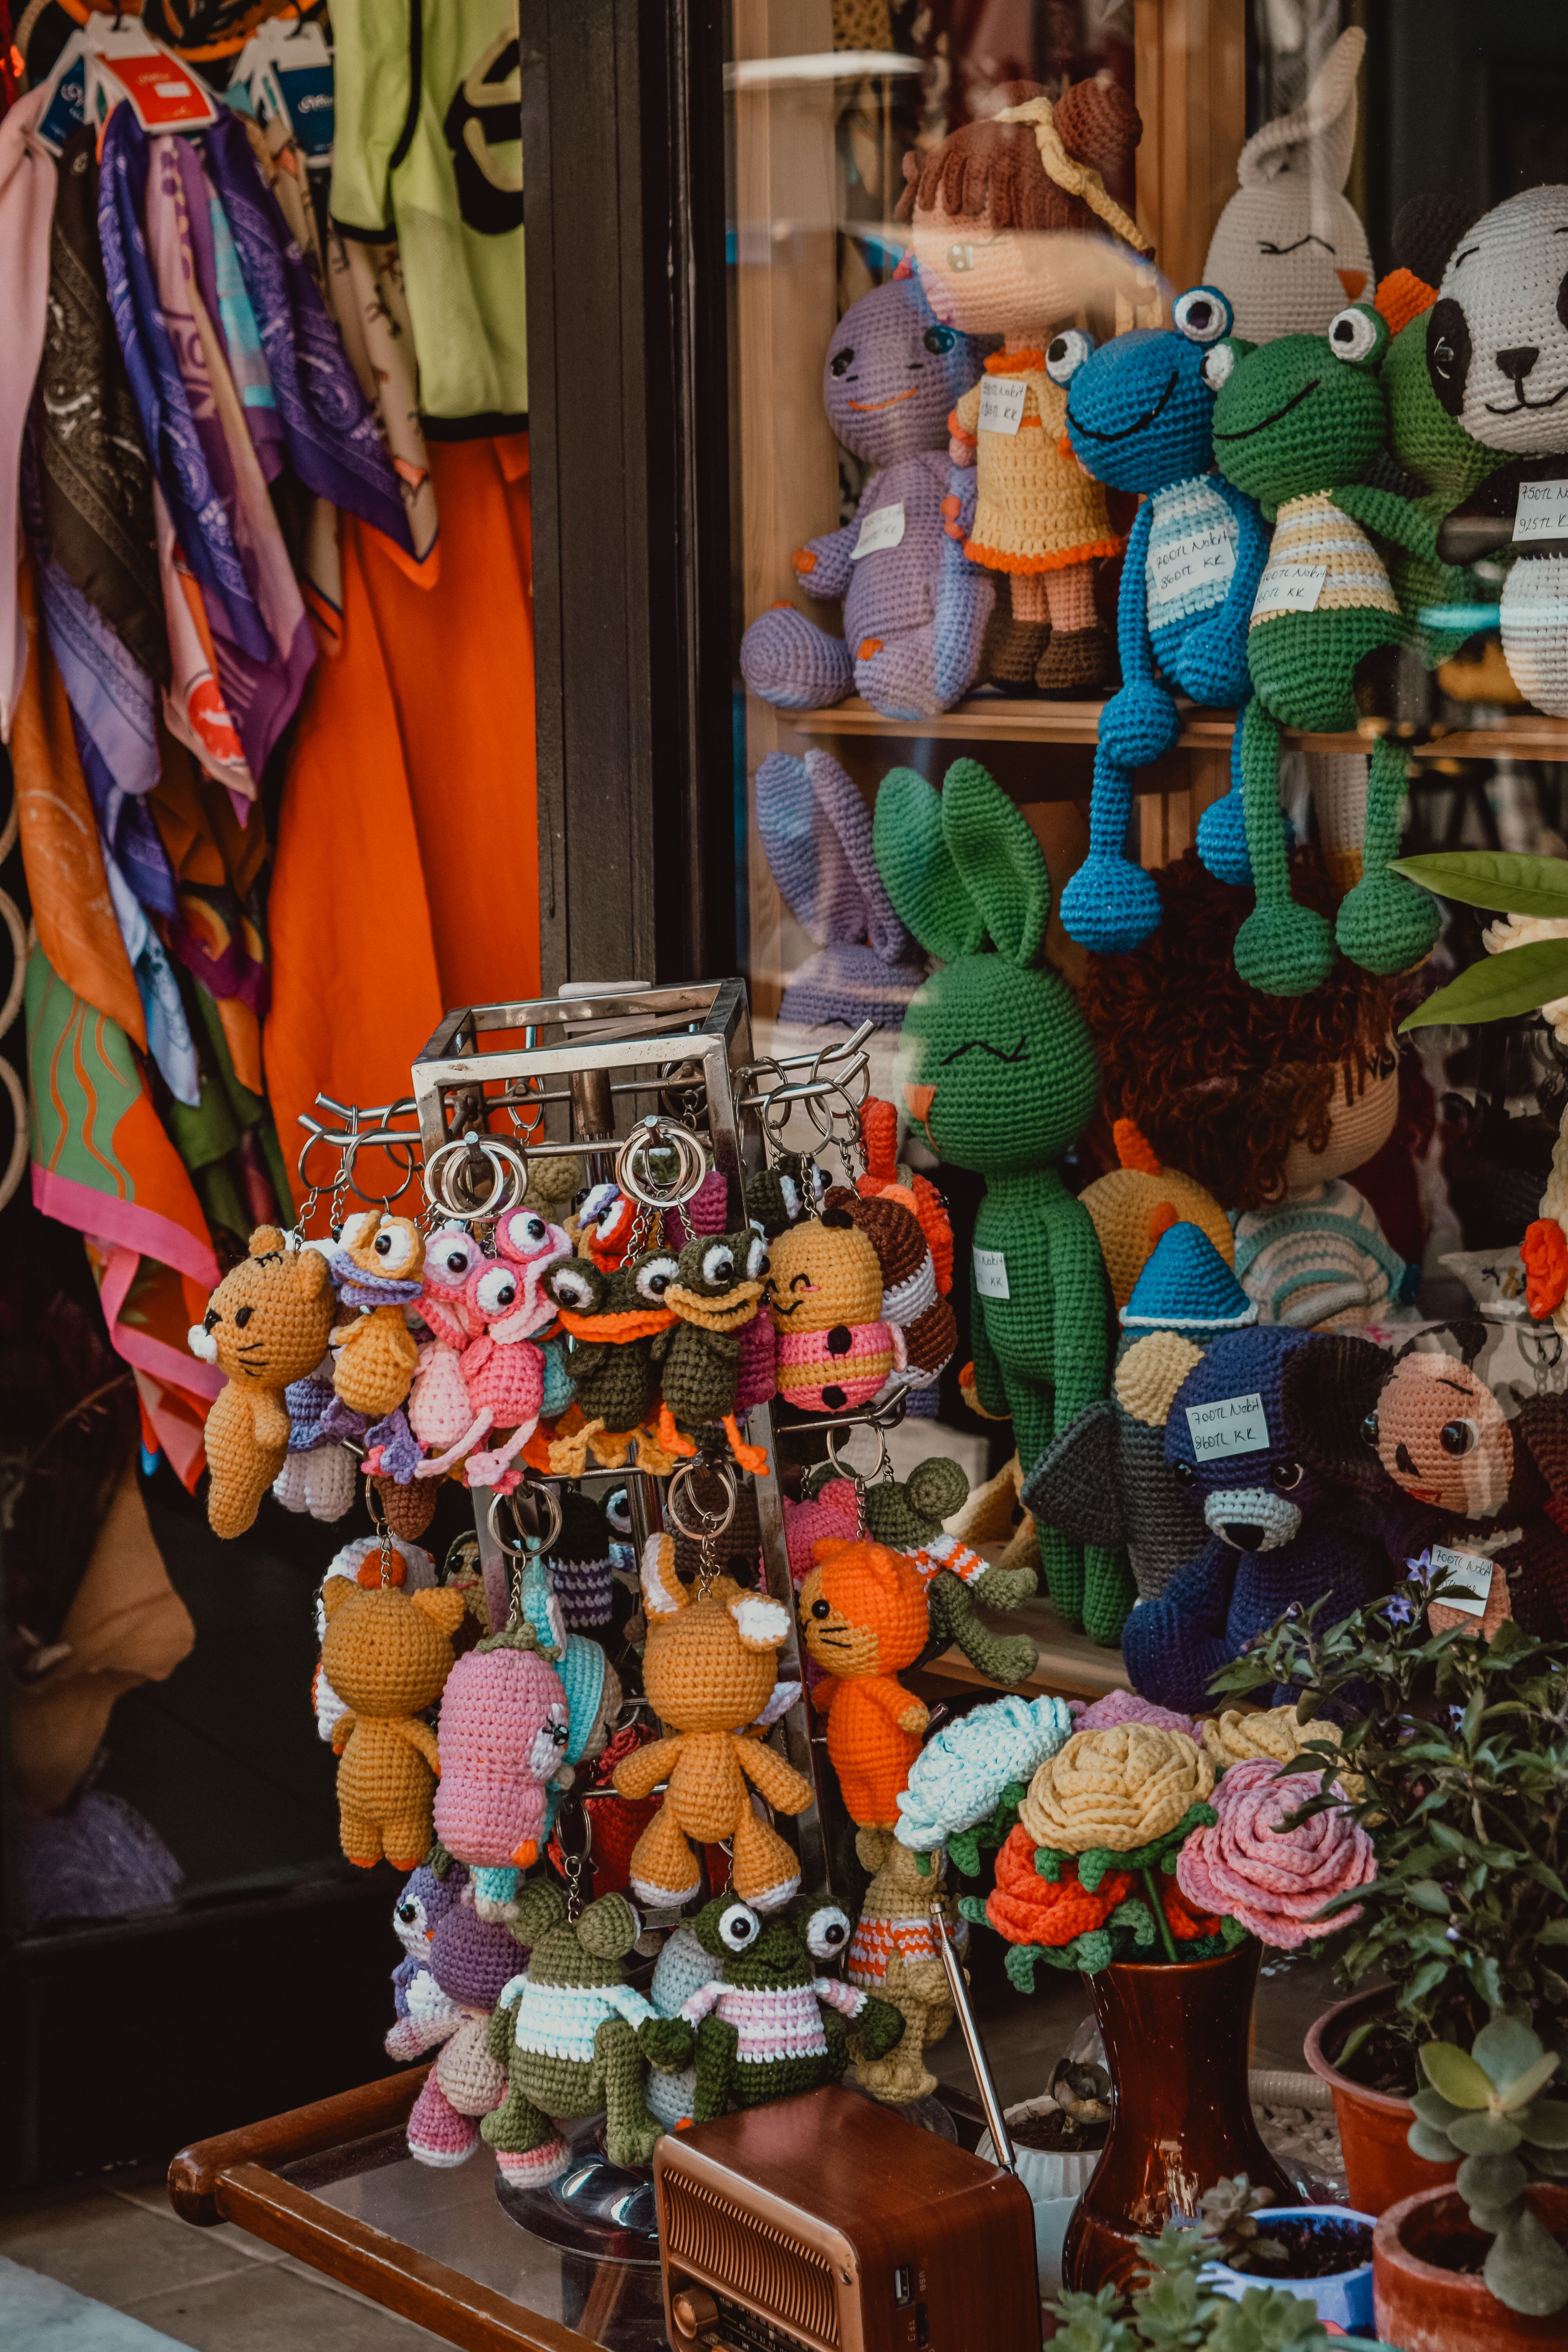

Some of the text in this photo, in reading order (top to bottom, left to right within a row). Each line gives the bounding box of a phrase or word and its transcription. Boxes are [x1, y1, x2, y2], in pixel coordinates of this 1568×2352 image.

[1522, 486, 1552, 500] 750TL
[1203, 555, 1226, 568] KK
[1287, 588, 1304, 597] KK
[991, 1276, 1003, 1288] KK
[1192, 1408, 1227, 1425] 700TL
[1195, 1428, 1256, 1450] 860TL KK
[1437, 1550, 1463, 1568] 700TL
